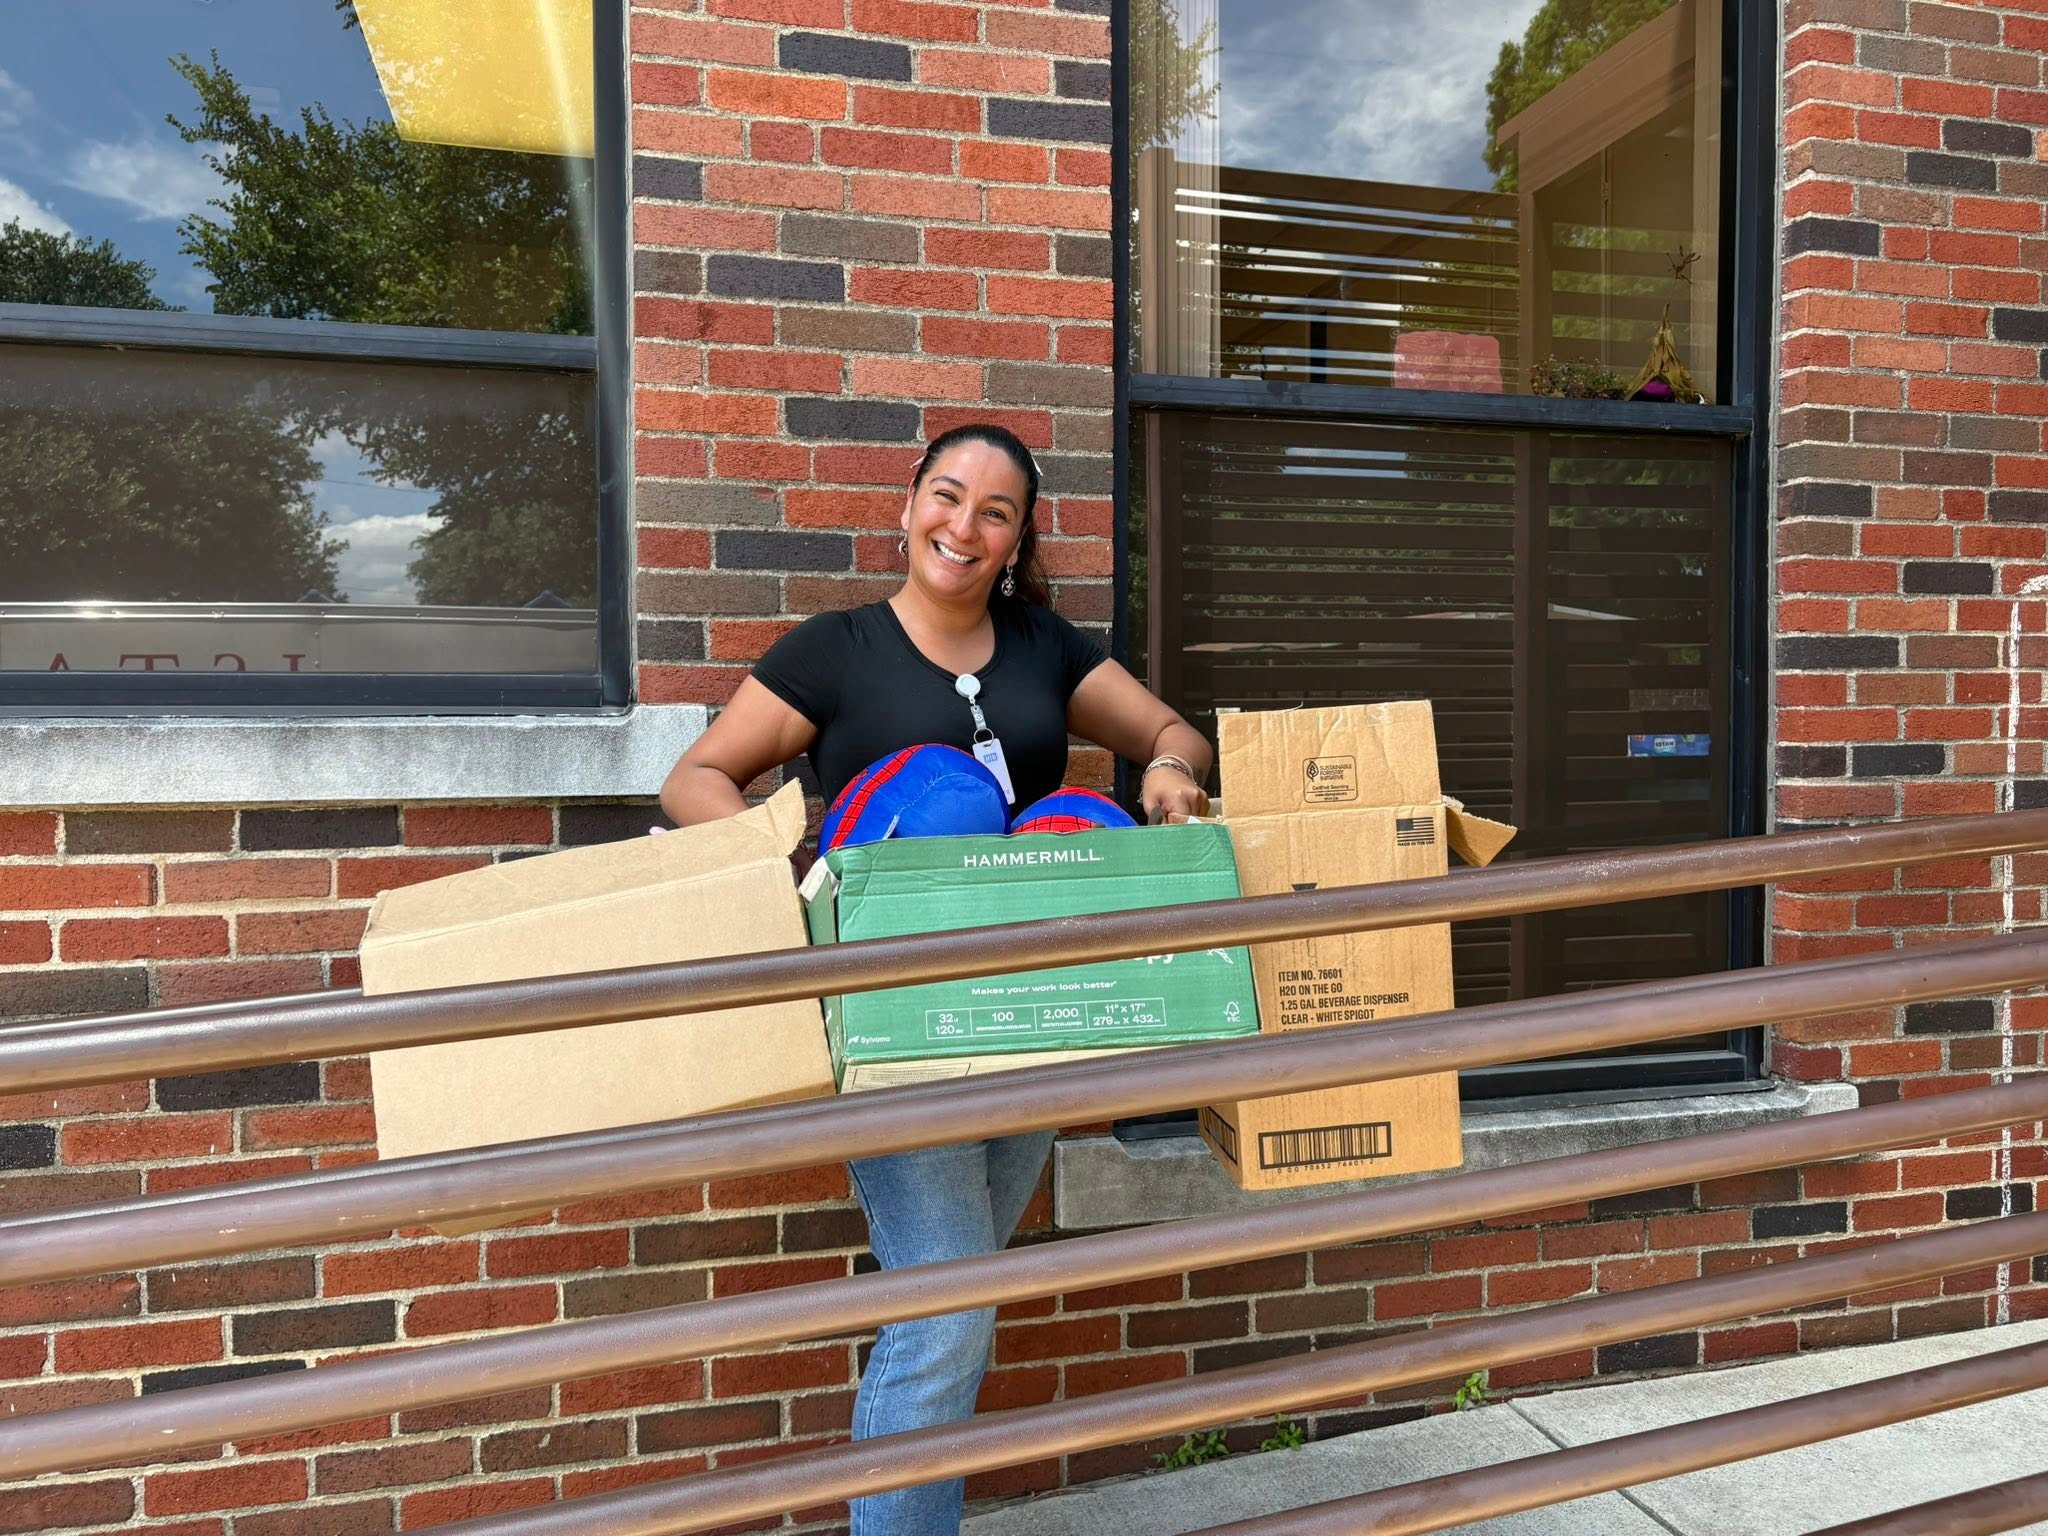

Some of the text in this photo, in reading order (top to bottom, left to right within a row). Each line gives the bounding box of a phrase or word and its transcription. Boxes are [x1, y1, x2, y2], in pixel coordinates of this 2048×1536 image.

[1279, 968, 1342, 982] ITEM NO. 76601
[1007, 986, 1029, 994] your
[1032, 984, 1056, 992] work
[1060, 982, 1080, 990] look
[1298, 984, 1310, 995] ON
[1312, 984, 1328, 994] THE
[1331, 982, 1342, 992] GO
[1280, 992, 1409, 1010] 1.25 GAL BEVERAGE DISPENSER
[939, 1014, 954, 1023] 32
[992, 1012, 1014, 1022] 100
[1043, 1008, 1079, 1020] 2,000
[1132, 1014, 1154, 1023] 432
[1281, 1014, 1308, 1025] CLEAR
[1316, 1010, 1342, 1023] WHITE
[1344, 1009, 1375, 1021] SPIGOT
[936, 1025, 955, 1034] 120
